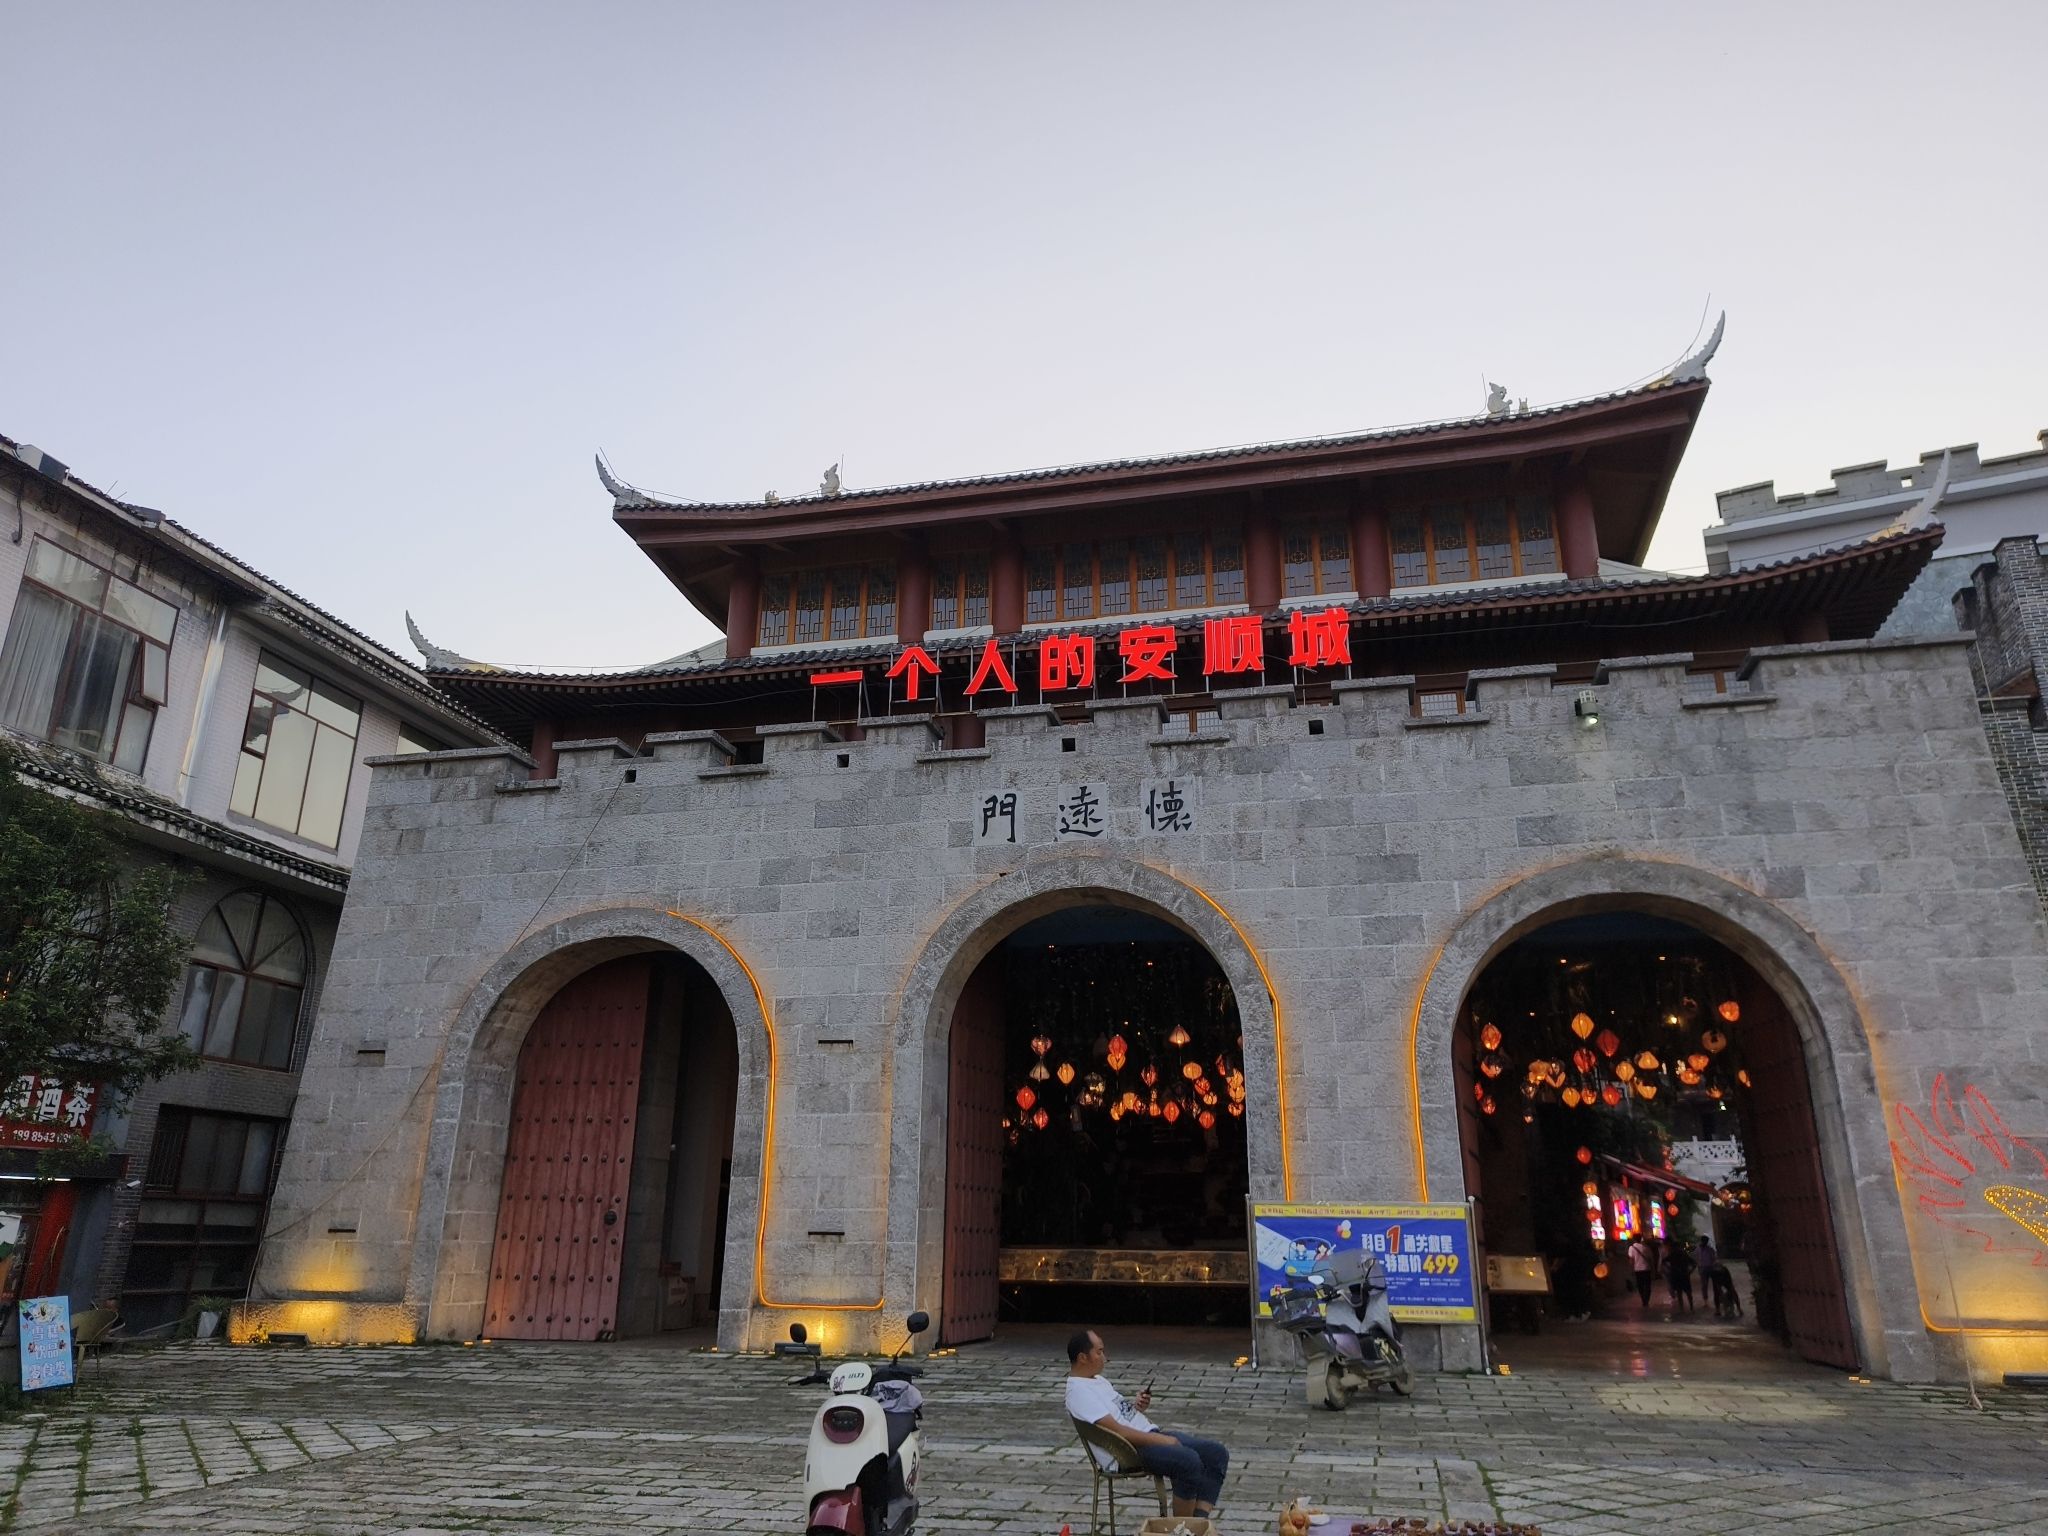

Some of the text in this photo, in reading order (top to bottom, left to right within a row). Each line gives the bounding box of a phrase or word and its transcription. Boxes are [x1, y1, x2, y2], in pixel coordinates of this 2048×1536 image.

[810, 607, 1352, 702] 一个人的安顺城
